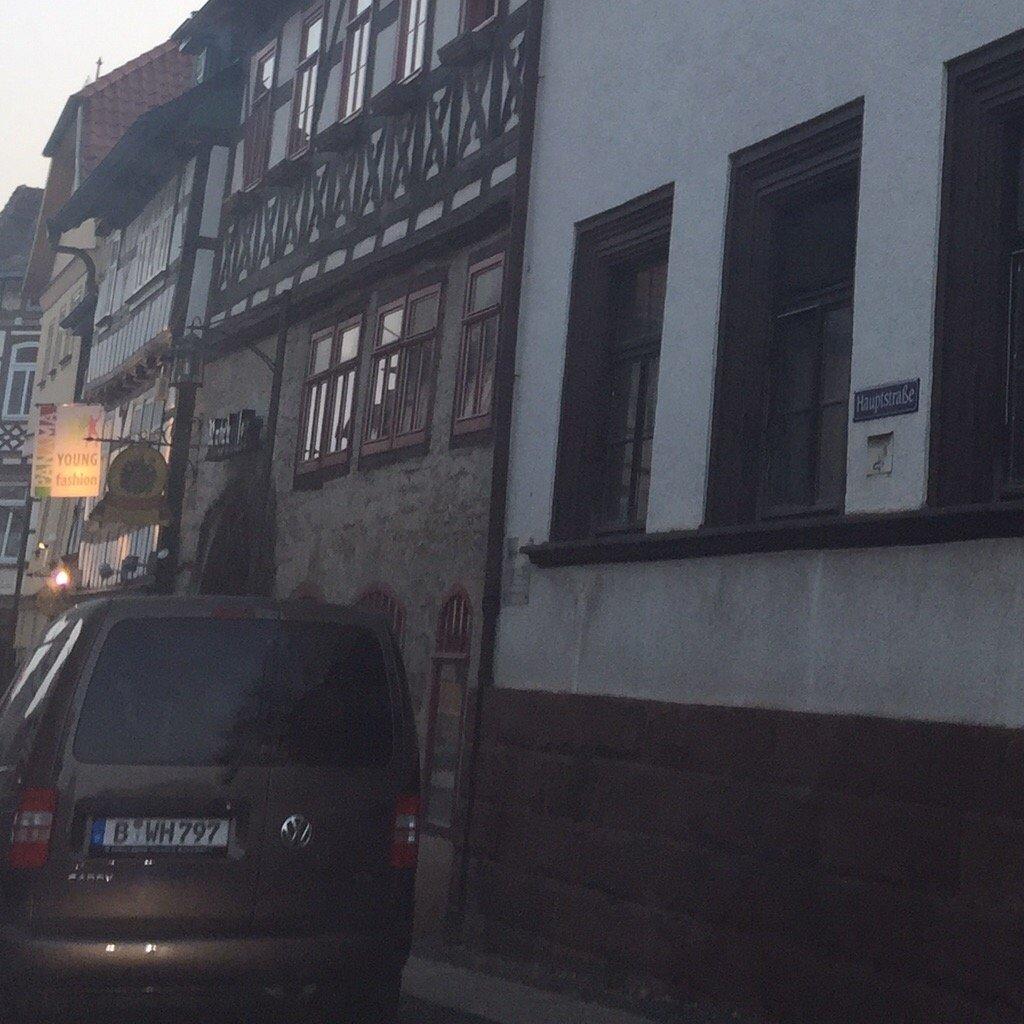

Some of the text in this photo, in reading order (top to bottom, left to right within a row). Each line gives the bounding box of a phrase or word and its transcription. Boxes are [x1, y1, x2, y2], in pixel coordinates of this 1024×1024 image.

[857, 384, 915, 413] Hauptstraße
[57, 453, 98, 467] YOUNG
[56, 472, 98, 487] fashion
